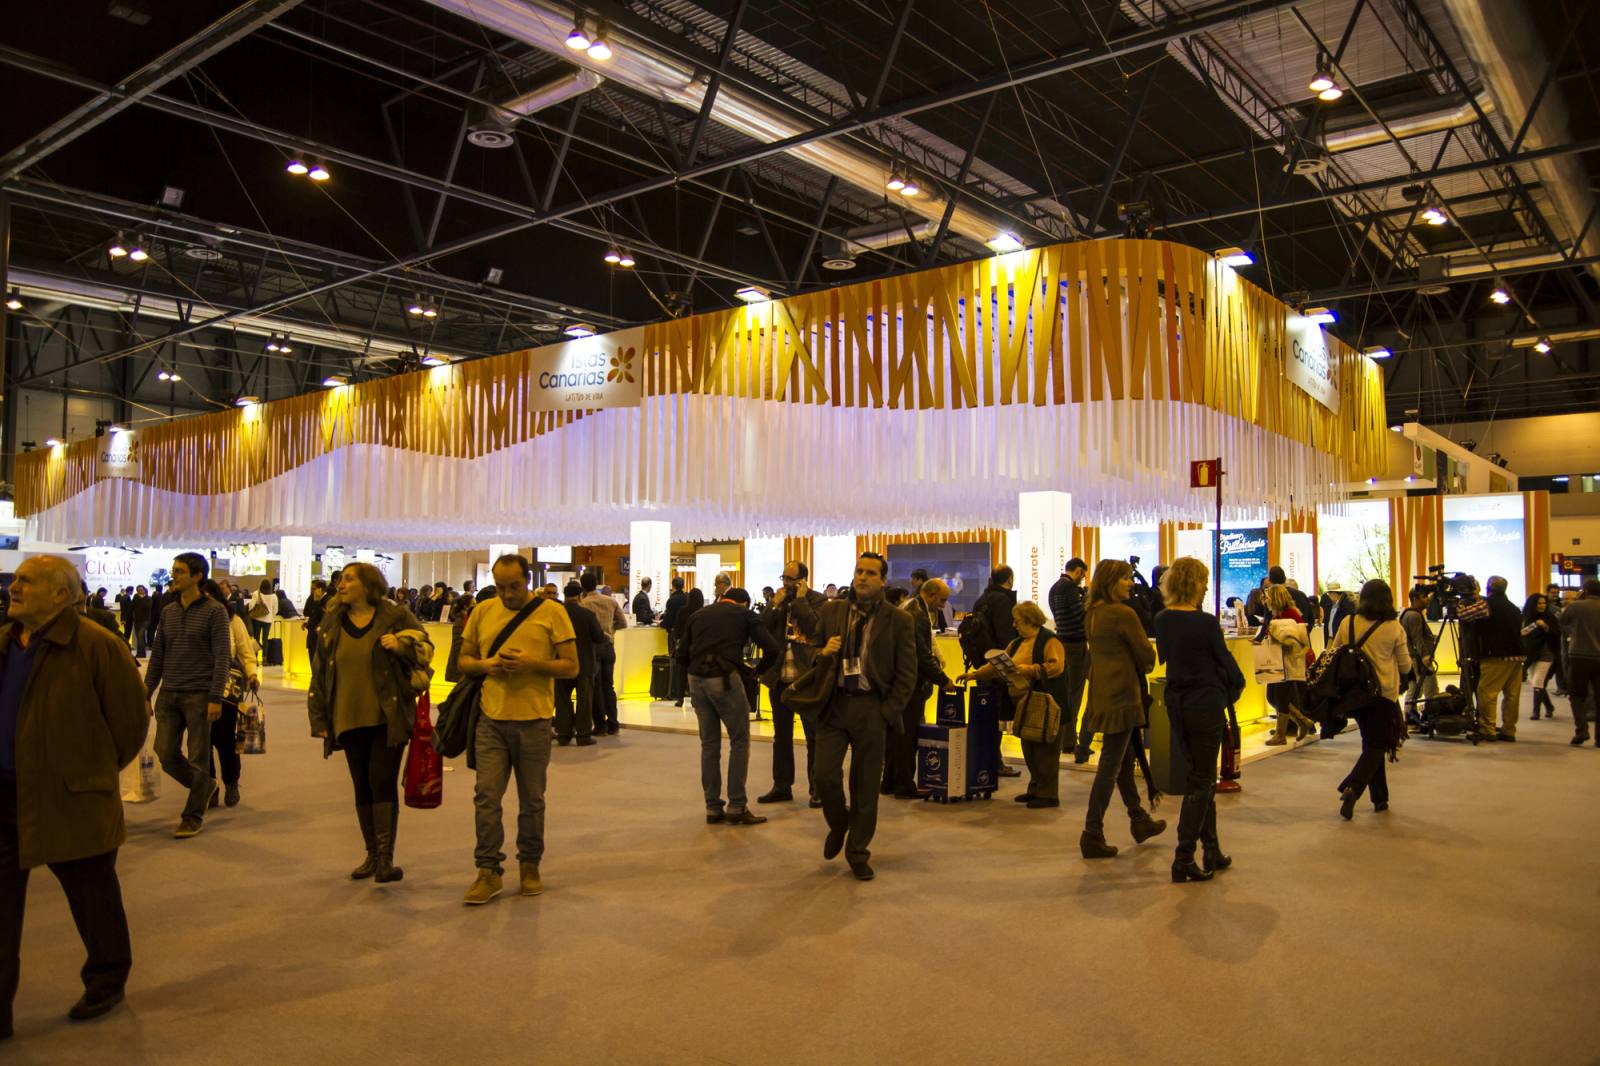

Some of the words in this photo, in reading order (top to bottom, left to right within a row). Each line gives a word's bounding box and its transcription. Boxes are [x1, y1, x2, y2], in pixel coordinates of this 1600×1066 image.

[571, 352, 606, 369] Islas
[539, 370, 605, 389] Canarias
[85, 560, 132, 576] CICAR
